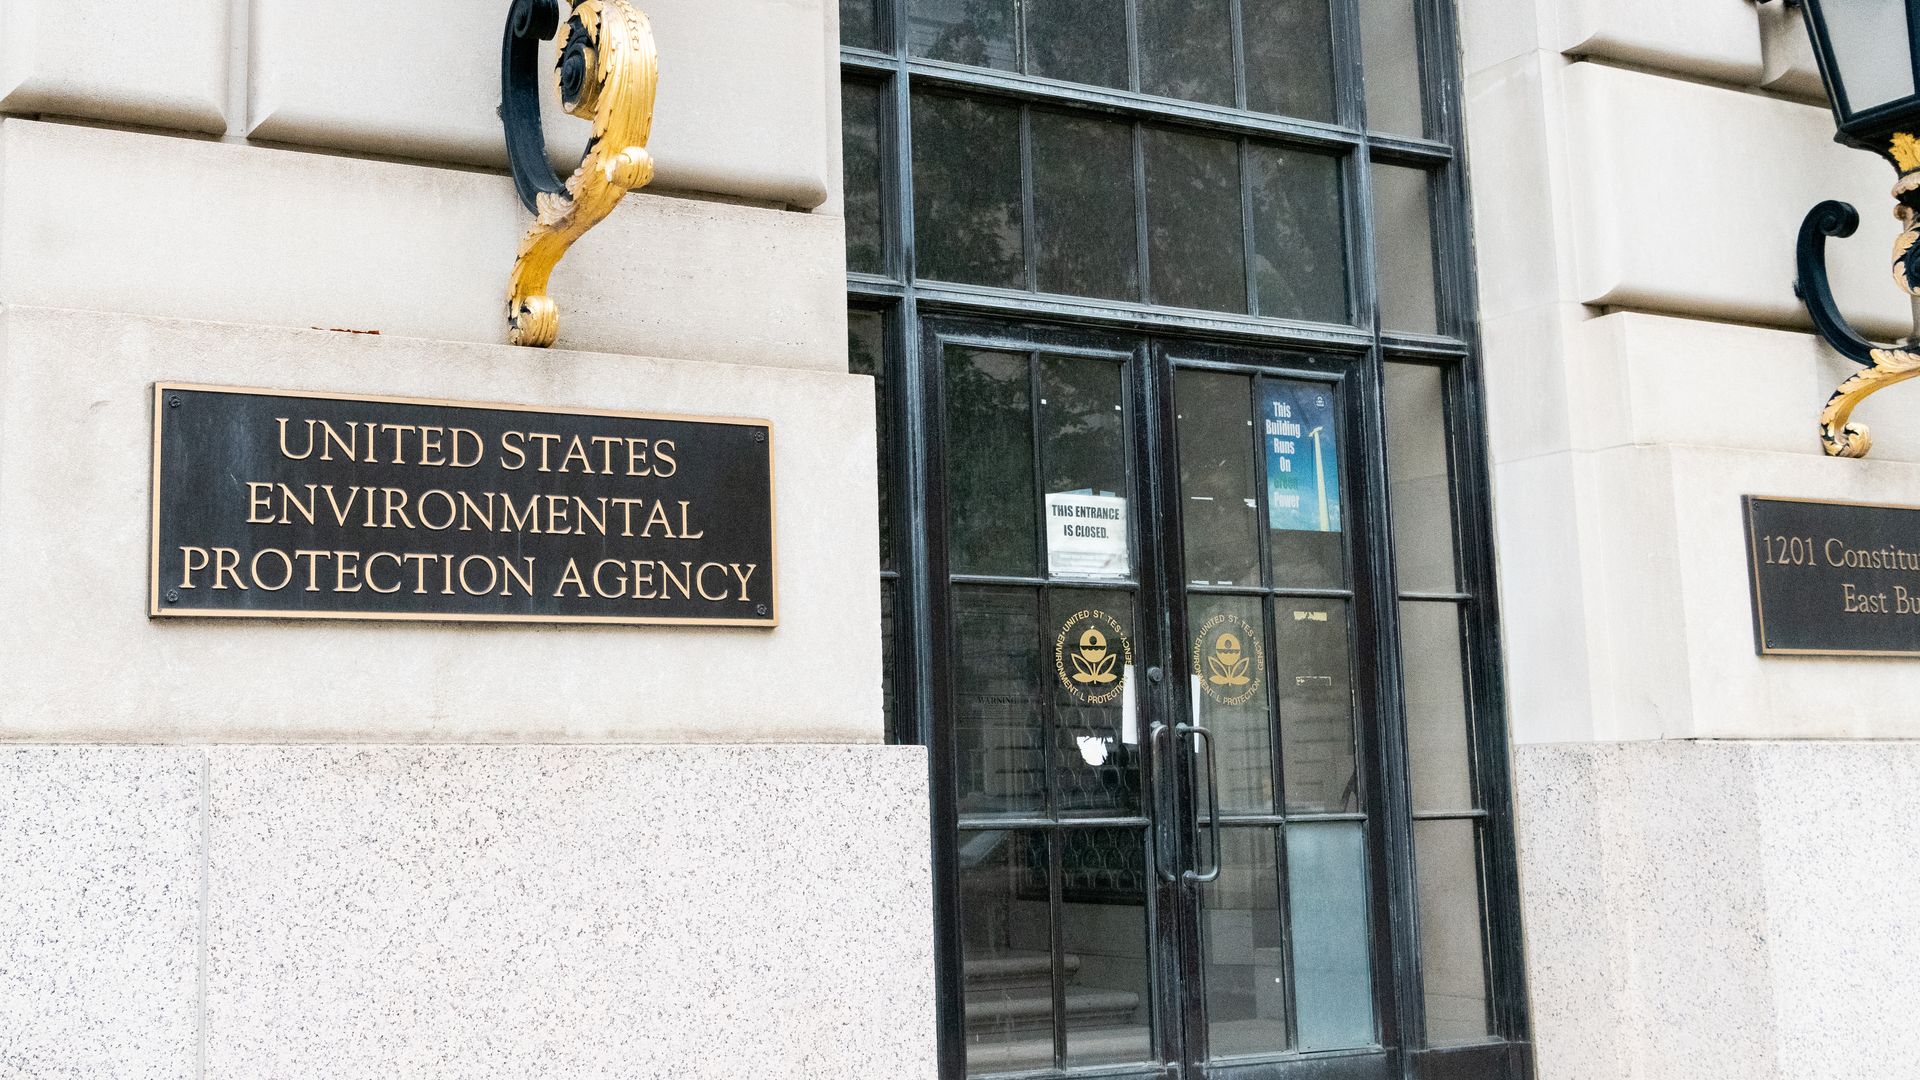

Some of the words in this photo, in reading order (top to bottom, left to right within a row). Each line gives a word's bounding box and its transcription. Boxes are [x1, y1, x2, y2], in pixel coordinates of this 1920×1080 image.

[1273, 402, 1291, 418] This
[1266, 419, 1300, 438] Building
[276, 418, 484, 469] UNITED
[500, 432, 677, 478] STATES
[1274, 438, 1294, 454] Runs
[1280, 456, 1291, 472] On
[1274, 491, 1299, 508] Power
[246, 482, 704, 540] ENVIRONMENTAL
[1052, 505, 1073, 517] THIS
[1076, 506, 1120, 520] ENTRANCE
[1064, 524, 1073, 536] IS
[1076, 525, 1108, 538] CLOSED.
[1763, 536, 1816, 566] 1201
[180, 546, 536, 597] PROTECTION
[553, 558, 756, 602] AGENCY
[1841, 584, 1888, 613] East
[1062, 610, 1089, 632] UNITED
[1093, 610, 1121, 633] STTES
[1200, 614, 1225, 635] UNITED
[1228, 614, 1253, 636] STTES
